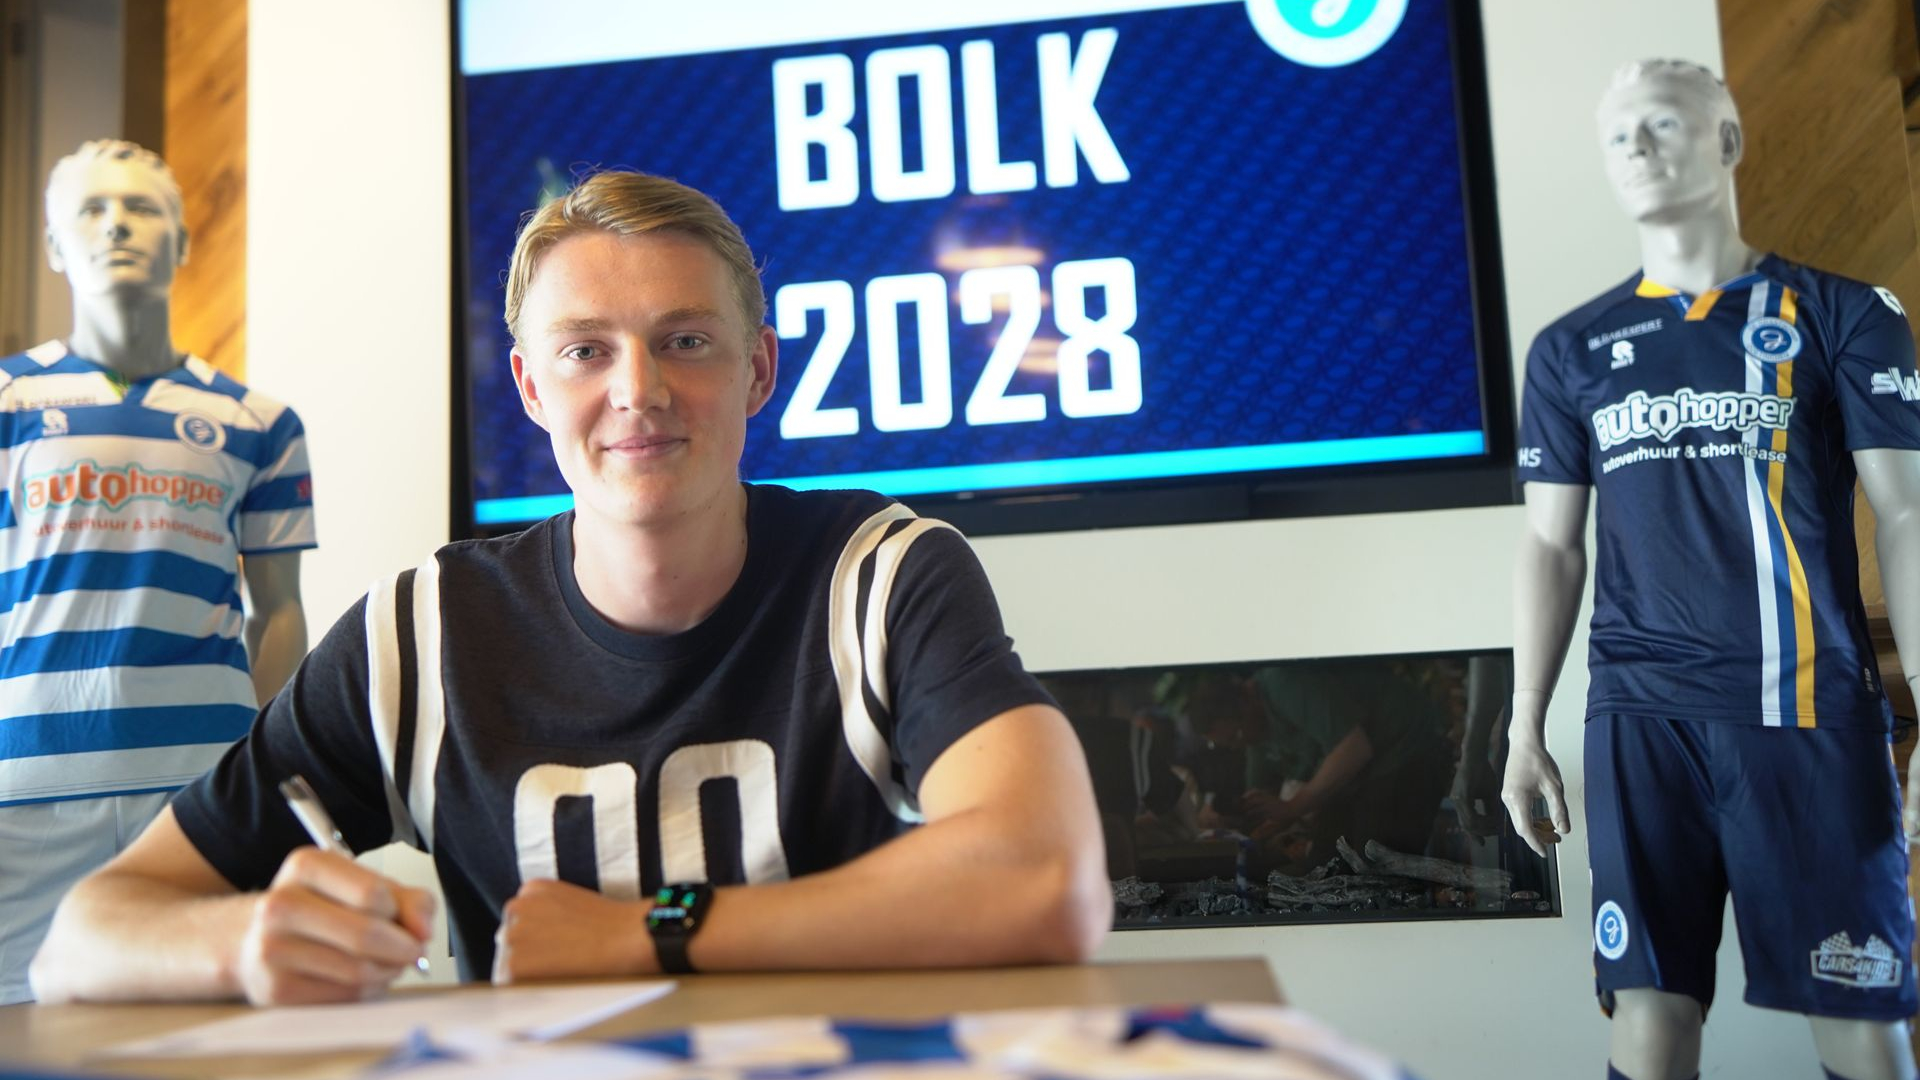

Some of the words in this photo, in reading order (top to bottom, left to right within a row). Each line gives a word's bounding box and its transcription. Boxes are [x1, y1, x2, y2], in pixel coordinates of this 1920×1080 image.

[772, 28, 1131, 211] BOLK
[775, 257, 1143, 440] 2028
[1594, 389, 1794, 448] autohopper
[26, 465, 225, 508] autohoppe
[1603, 445, 1679, 474] autoverhuur
[1684, 445, 1696, 459] &
[1700, 442, 1787, 463] shortlease
